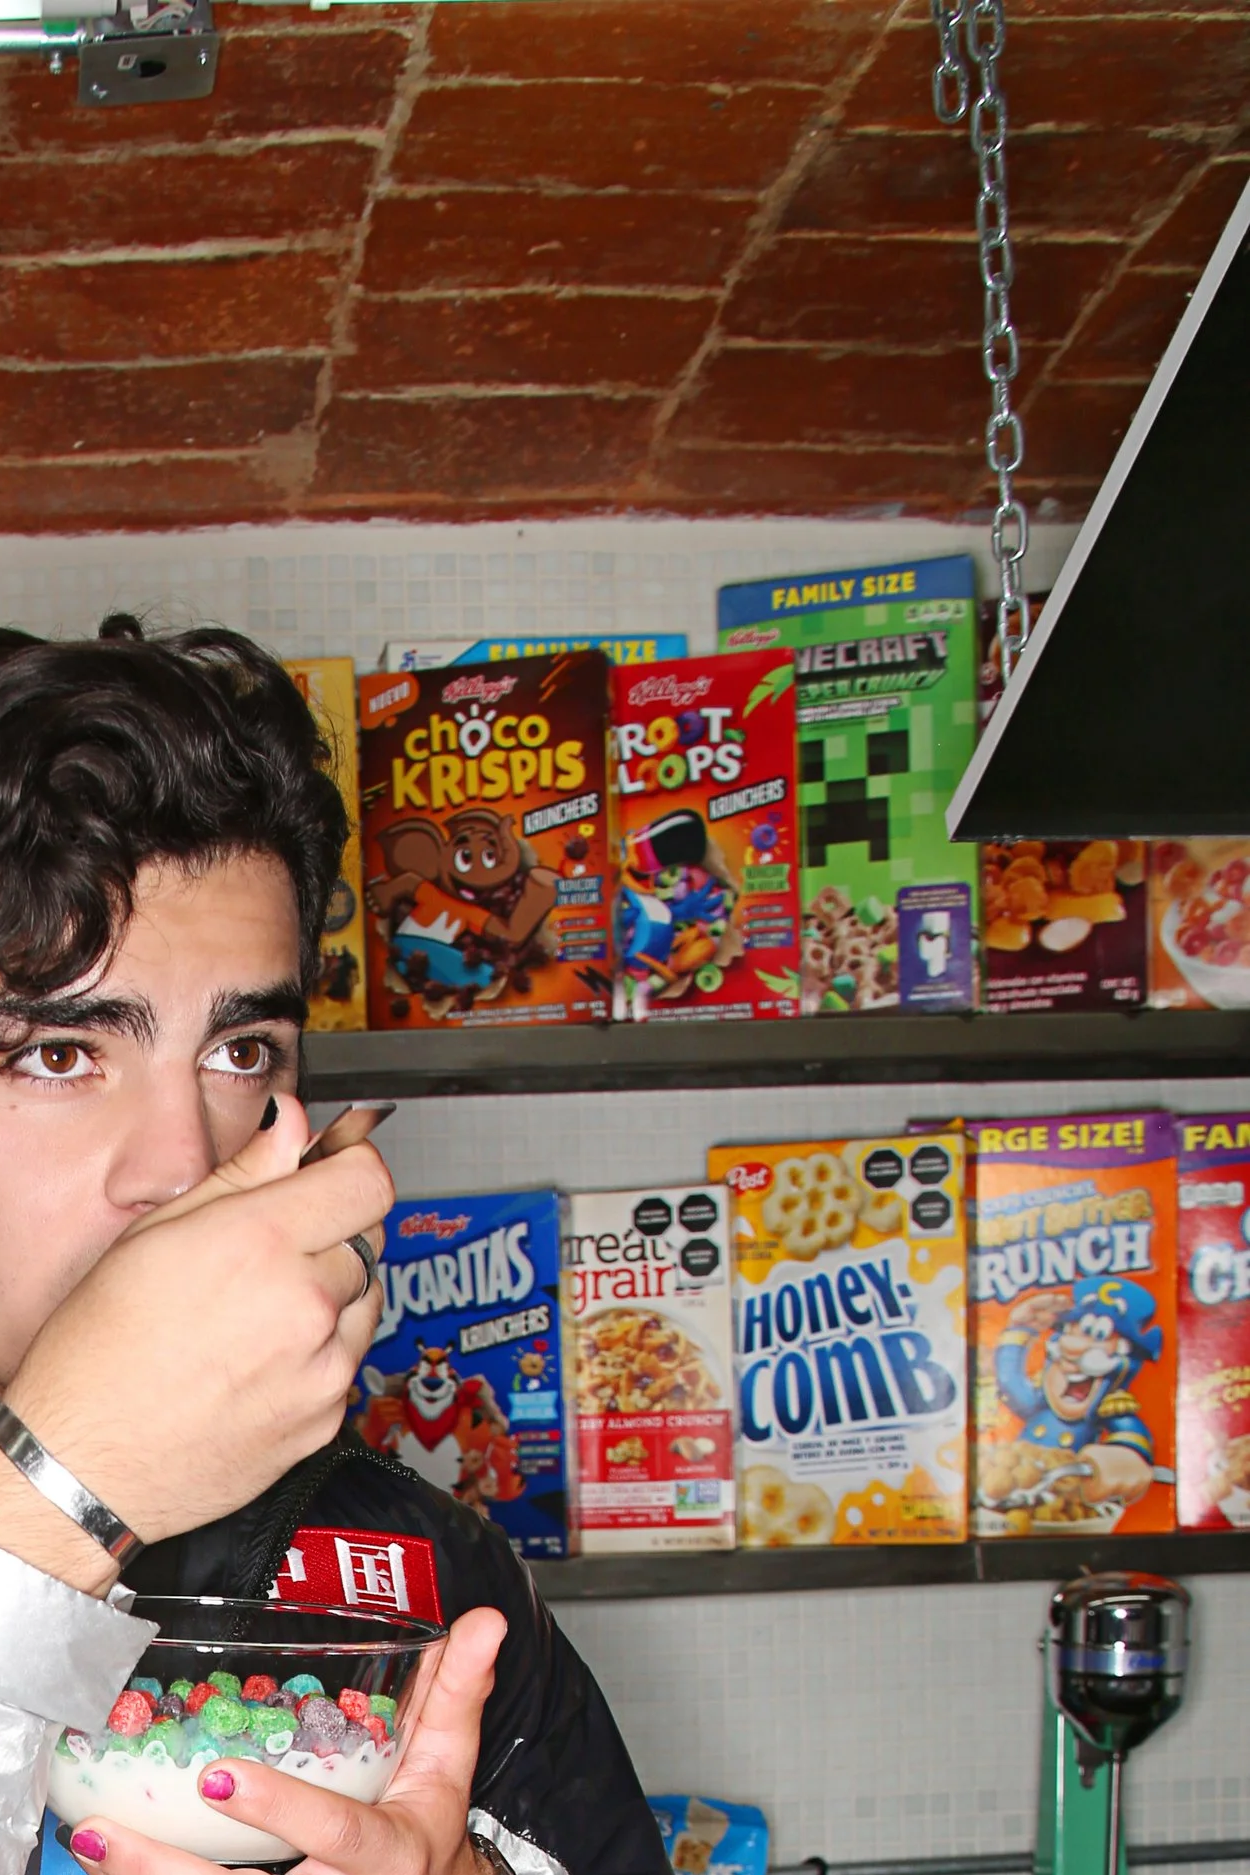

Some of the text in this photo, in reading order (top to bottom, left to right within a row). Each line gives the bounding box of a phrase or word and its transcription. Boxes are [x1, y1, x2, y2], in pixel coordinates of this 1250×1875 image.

[772, 571, 917, 610] FAMILY SIZE
[727, 625, 780, 649] Kellogg's
[369, 681, 410, 713] NUEVO
[442, 675, 519, 702] Kellogg's
[628, 674, 714, 705] Kellogg's
[612, 706, 733, 761] ROOT
[392, 740, 587, 812] KRISPIS
[619, 742, 744, 795] LOOPS
[709, 779, 785, 820] KRUNCHERS
[978, 1119, 1145, 1154] RGE SIZE!
[727, 1165, 768, 1191] Post
[399, 1212, 472, 1239] Kellogg's
[461, 1304, 549, 1353] KRUNCHERS
[608, 1414, 724, 1428] ALMOND CRUNCH
